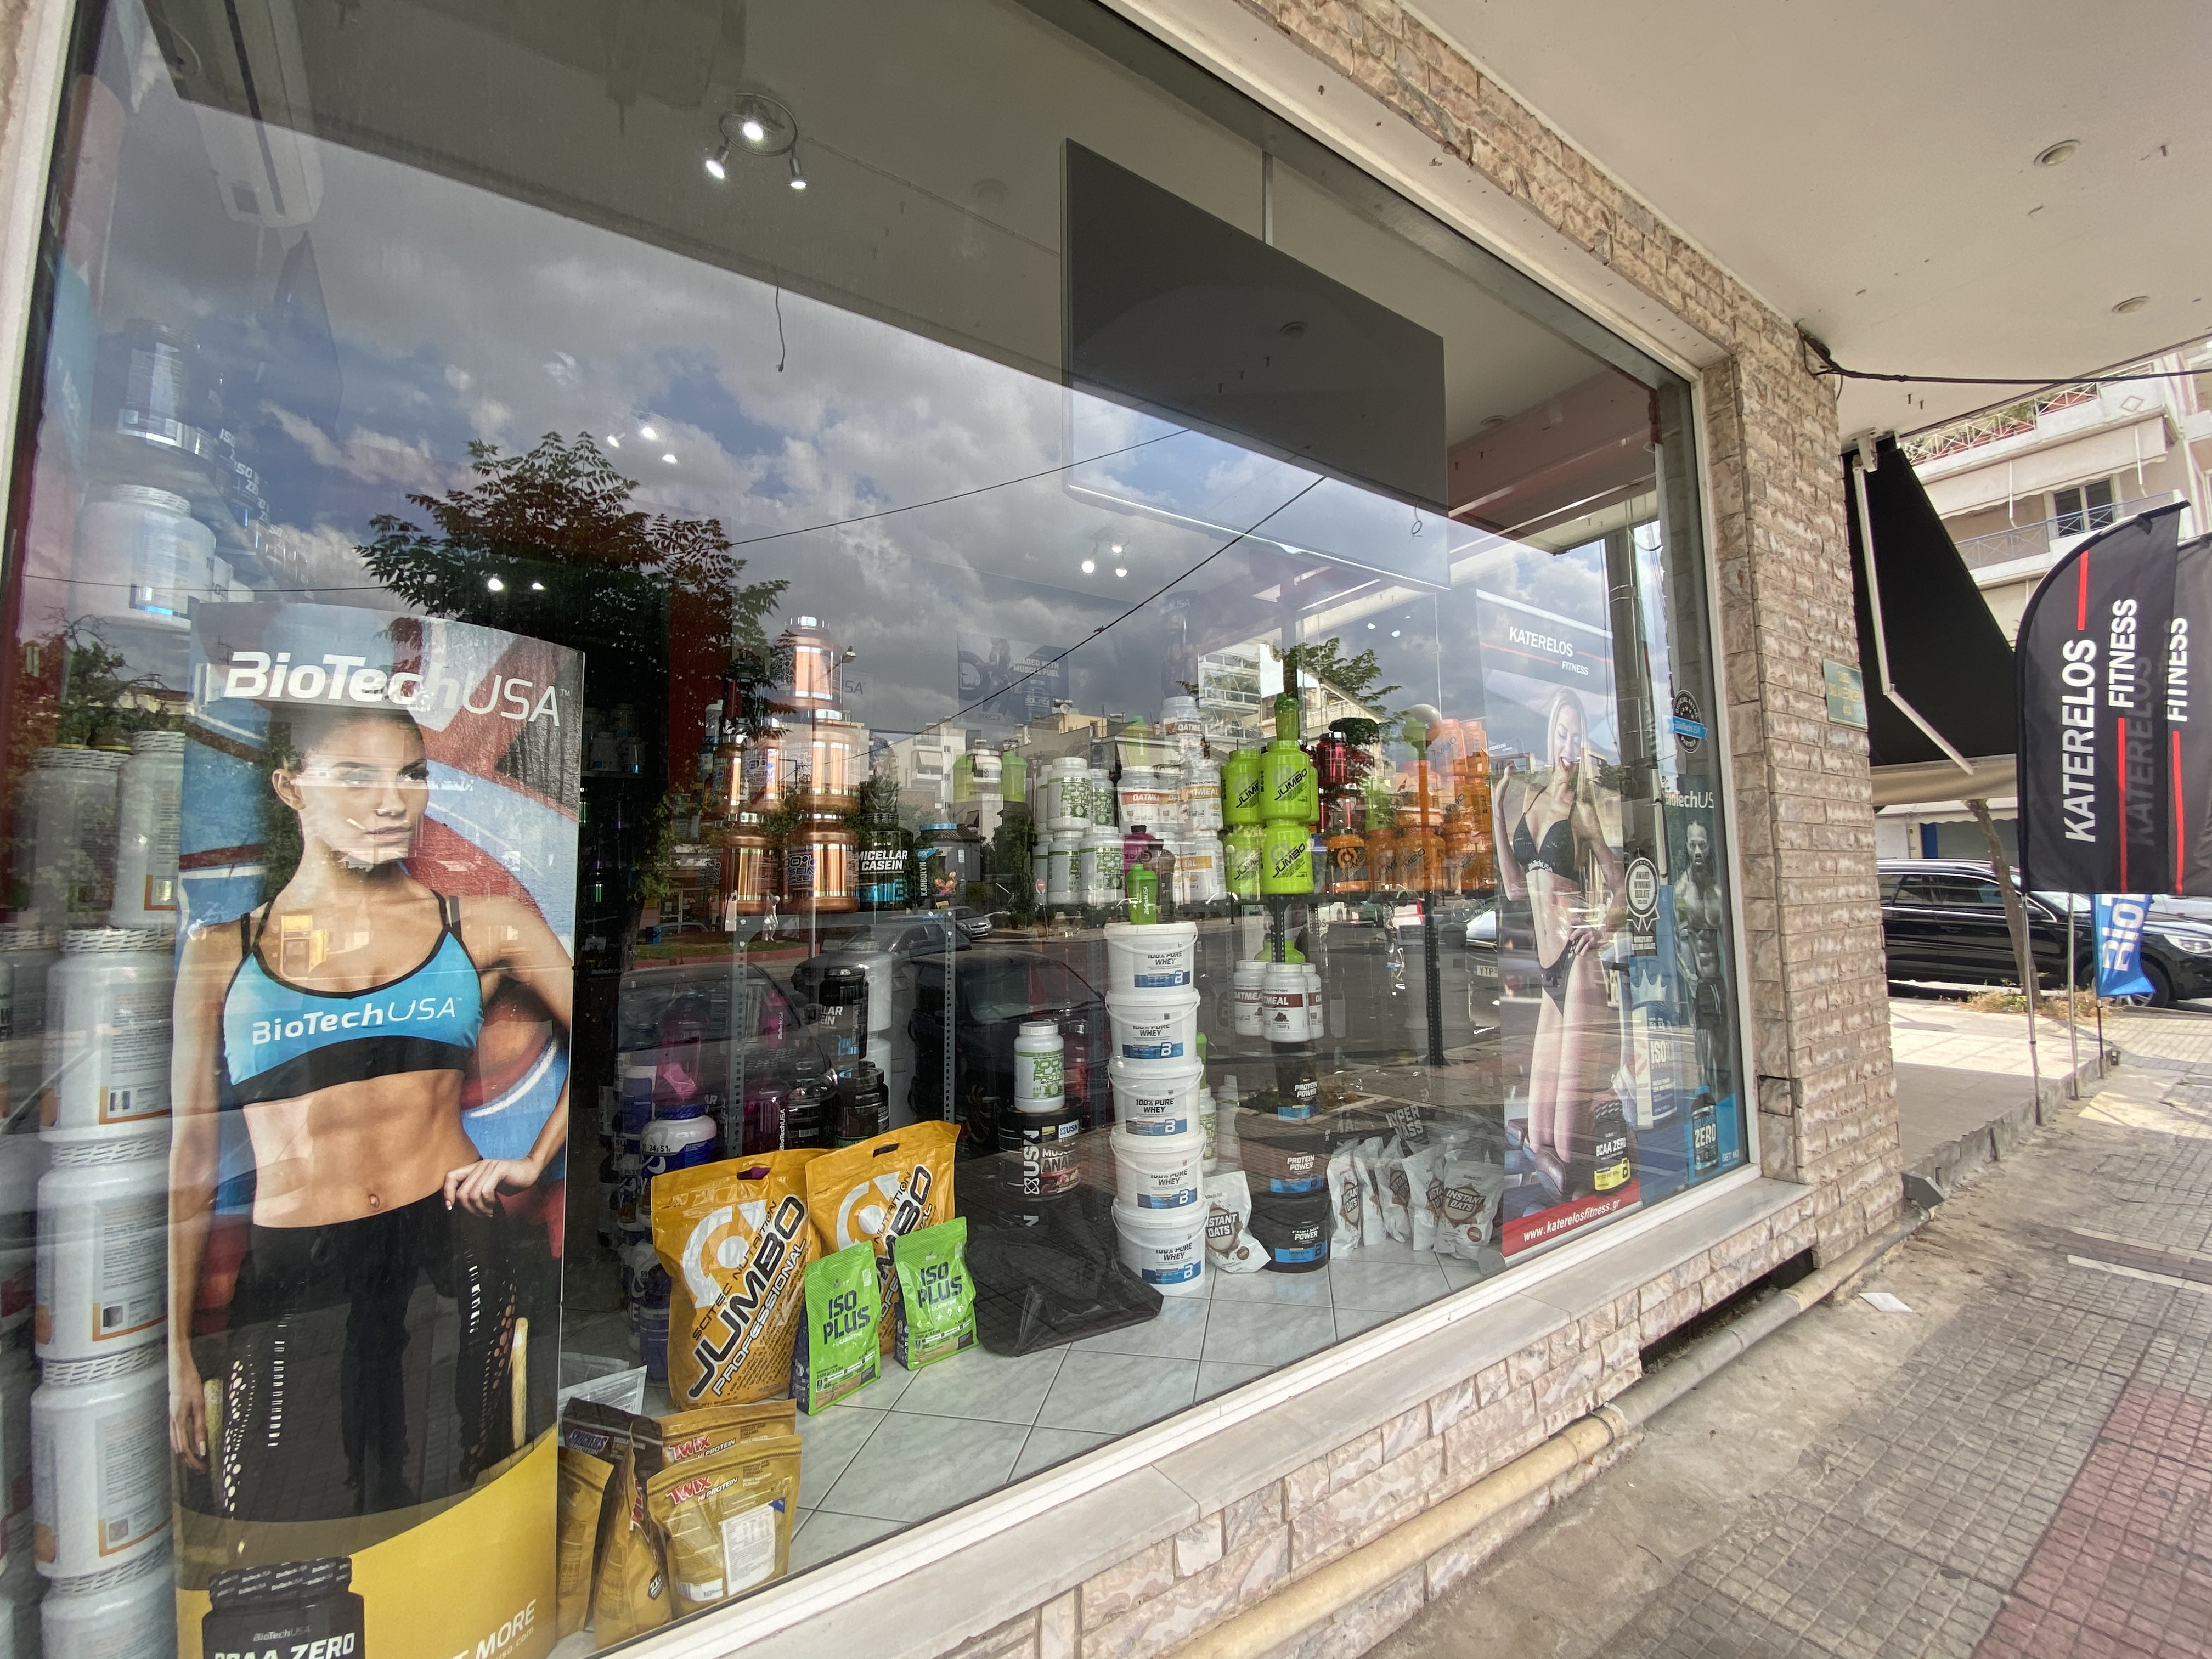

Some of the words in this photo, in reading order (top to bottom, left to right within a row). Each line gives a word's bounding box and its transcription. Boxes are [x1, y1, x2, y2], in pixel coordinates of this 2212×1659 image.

[1509, 627, 1573, 657] KATERELOS
[2108, 598, 2138, 708] FITNESS
[1042, 669, 1059, 678] FUEL
[1562, 661, 1588, 675] FITNESS
[224, 651, 560, 726] BioTechUSA
[1178, 723, 1201, 731] OATME
[2062, 639, 2097, 843] KATERELOS
[1274, 768, 1307, 800] JUMBO
[1665, 791, 1714, 809] BioTechUS
[859, 850, 908, 861] MICELLAR
[1272, 843, 1306, 878] JUMBO
[788, 867, 817, 876] SEIN
[861, 860, 903, 871] CASEIN
[919, 861, 928, 896] KARBOLYN
[1634, 881, 1651, 889] WINNING
[1634, 890, 1650, 899] ISOLATE
[1234, 992, 1261, 1000] OATMEA
[1263, 997, 1289, 1005] TMEAL
[820, 1006, 843, 1015] LLAR
[252, 997, 455, 1045] BioTechUSA
[1295, 1081, 1317, 1091] PROTEIN
[1297, 1088, 1317, 1098] POWER
[1154, 1098, 1175, 1106] PURE
[1386, 1104, 1421, 1128] HYPER
[1066, 1125, 1079, 1134] USN
[1395, 1119, 1424, 1142] MASS
[1694, 1124, 1716, 1148] ZERO
[1596, 1143, 1612, 1157] BCAA
[1613, 1137, 1627, 1152] ZERO
[1287, 1154, 1315, 1164] PROTEIN
[1290, 1162, 1313, 1171] POWER
[1170, 1169, 1187, 1178] PURE
[1158, 1177, 1180, 1186] WHEY
[1446, 1189, 1485, 1204] INSTANT
[874, 1171, 911, 1245] NUTRITION
[1450, 1200, 1474, 1211] OATS
[1209, 1214, 1237, 1227] STANT
[1524, 1199, 1621, 1242] www.katerelosfitness.gr
[1208, 1225, 1231, 1237] OATS
[1295, 1231, 1318, 1240] POWER
[1175, 1243, 1192, 1252] PURE
[1163, 1251, 1186, 1261] WHEY
[692, 1283, 732, 1341] SCITEC
[732, 1201, 777, 1282] NUTRITION
[920, 1261, 949, 1287] ISO
[686, 1194, 808, 1400] JUMBO
[917, 1275, 963, 1309] PLUS
[828, 1289, 857, 1320] ISO
[712, 1238, 807, 1396] PROFESSIONAL
[823, 1305, 871, 1345] PLUS
[668, 1435, 712, 1462] TWIX
[706, 1438, 736, 1457] PROTEIN
[665, 1476, 712, 1505] TWIX
[253, 1626, 311, 1641] BioTechUSA
[476, 1599, 536, 1659] MORE
[290, 1632, 356, 1659] ZERO
